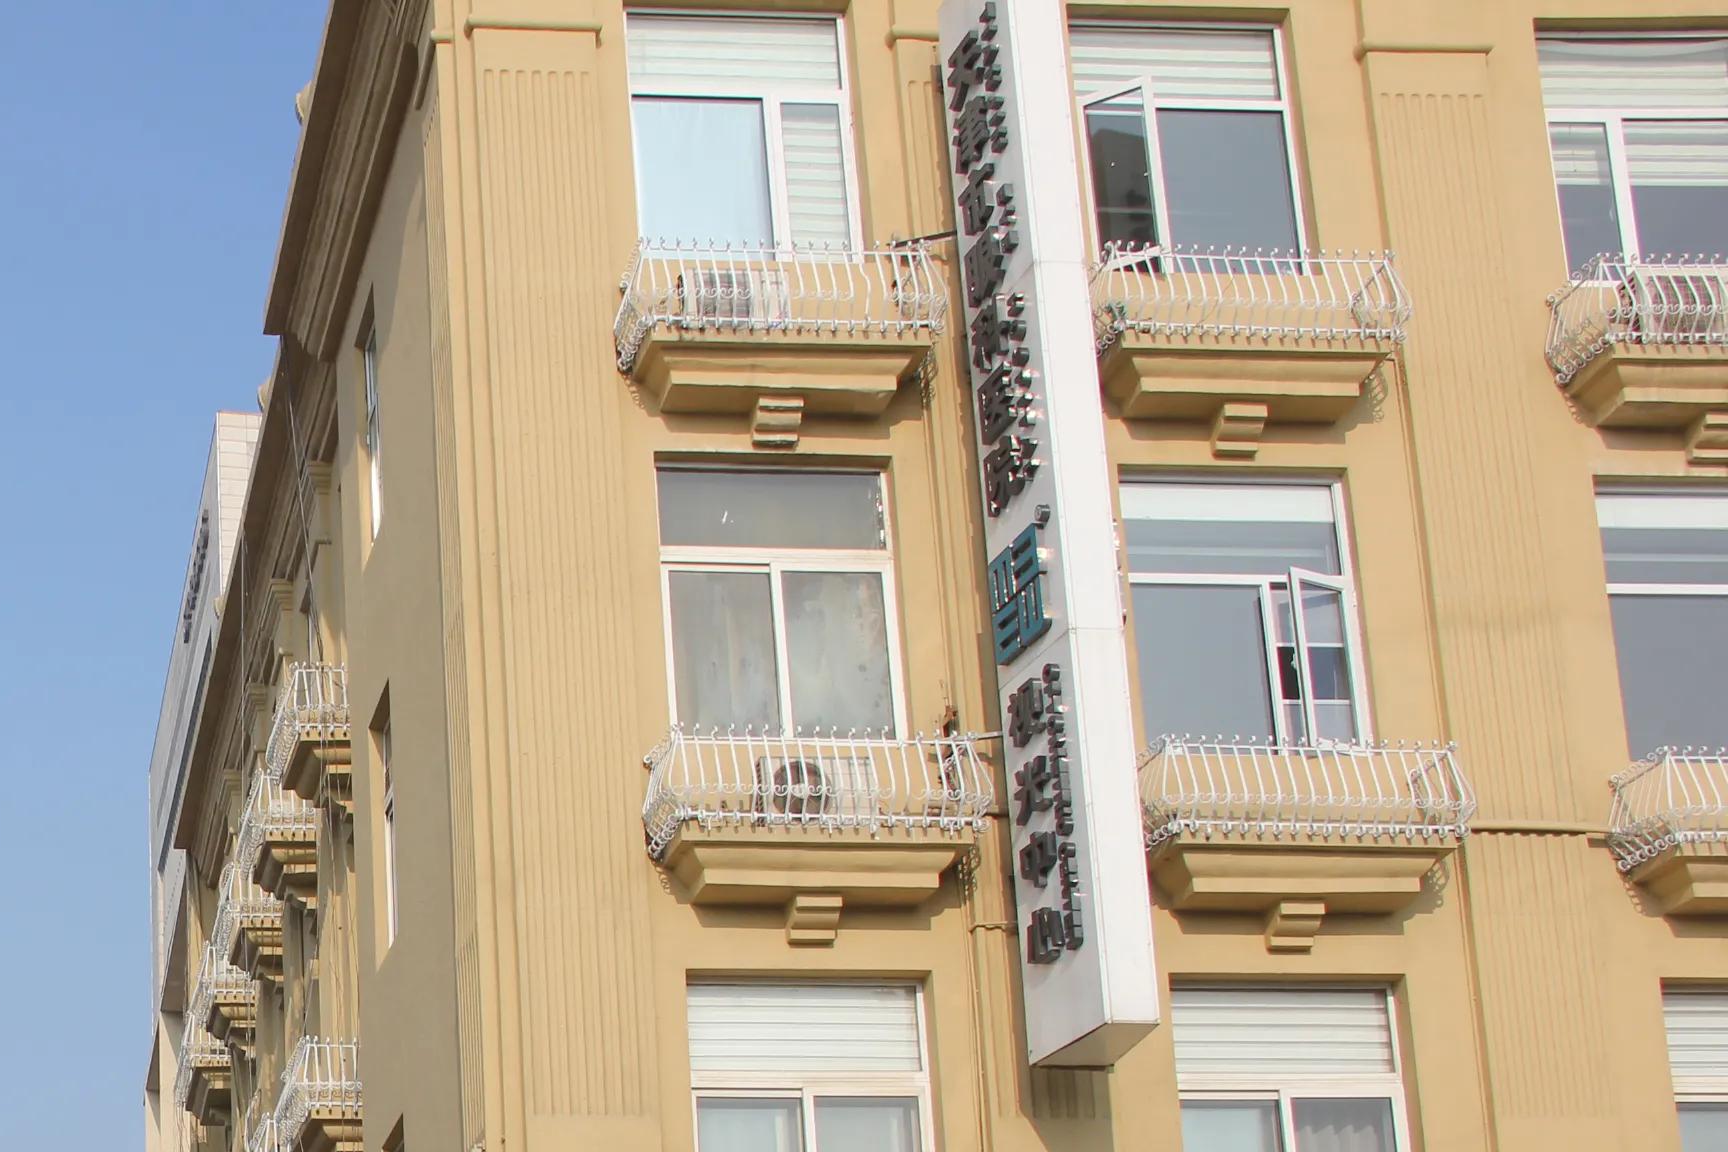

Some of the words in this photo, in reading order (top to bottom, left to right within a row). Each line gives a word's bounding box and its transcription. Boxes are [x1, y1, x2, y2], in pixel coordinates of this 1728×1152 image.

[948, 29, 1026, 518] 天津市眼科医院
[1007, 677, 1066, 965] 视光中心
